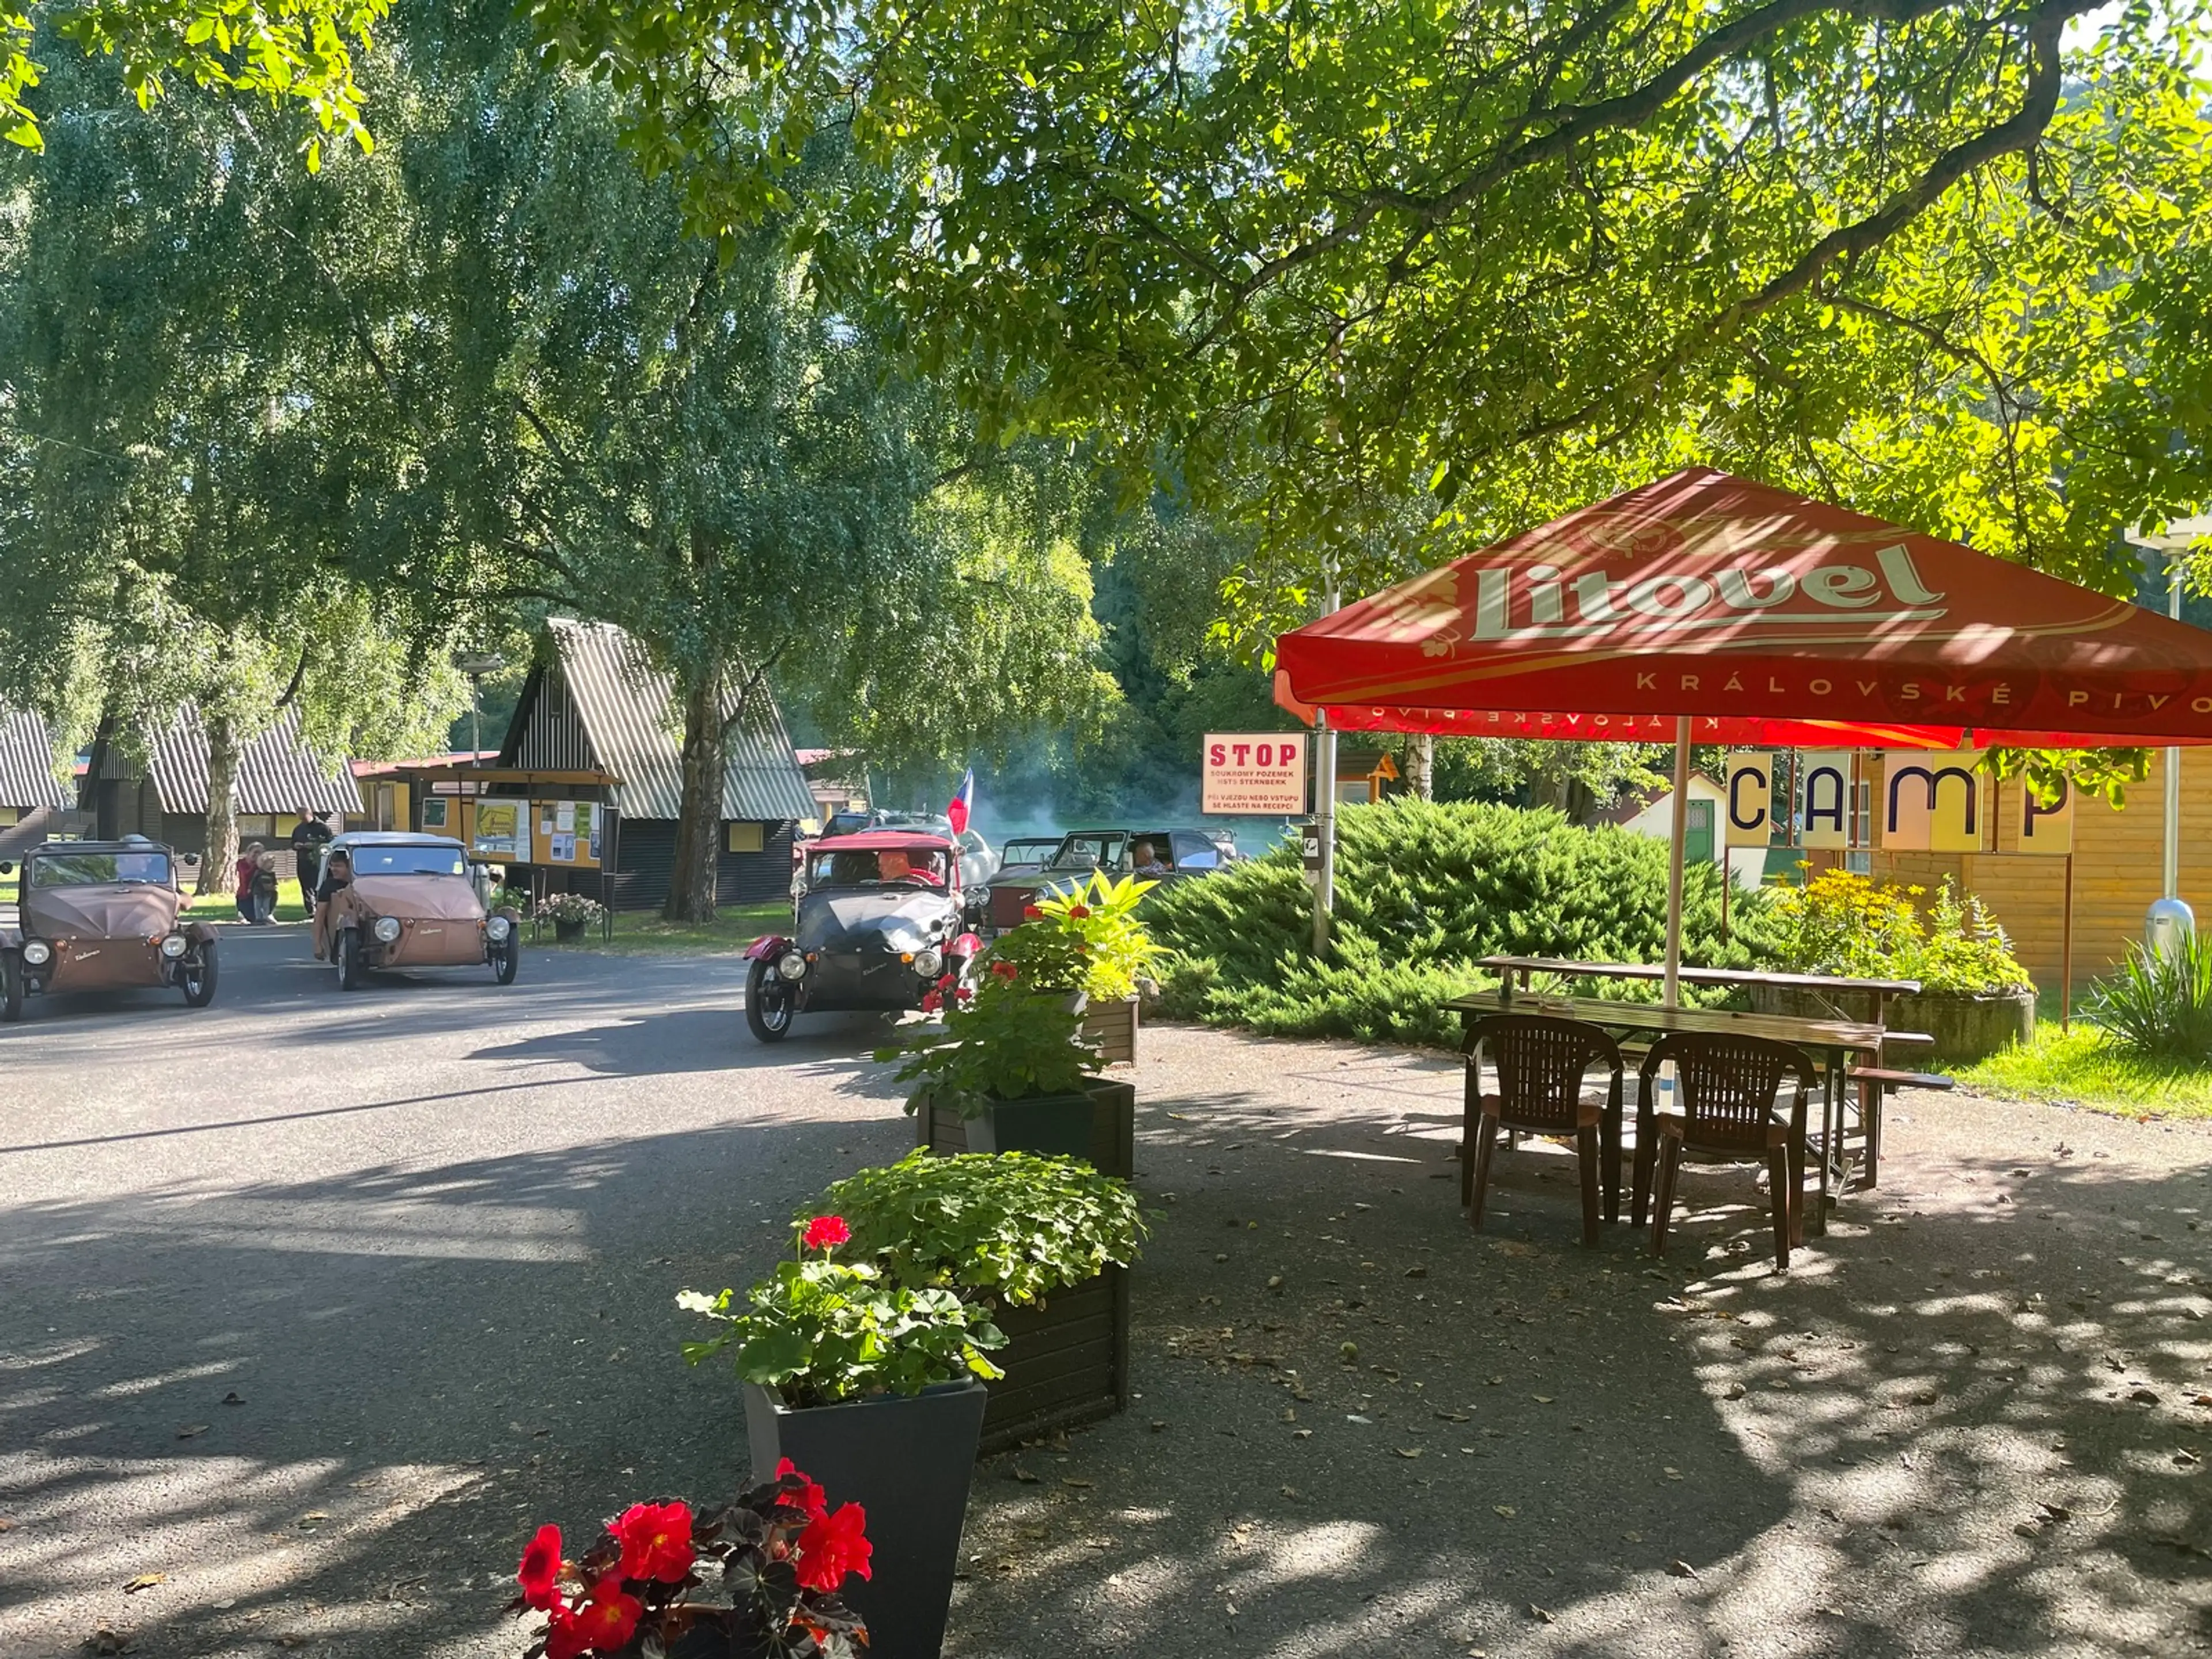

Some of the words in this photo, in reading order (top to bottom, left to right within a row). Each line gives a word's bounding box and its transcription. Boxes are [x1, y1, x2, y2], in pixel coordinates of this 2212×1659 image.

[1469, 543, 1948, 641] Litovel
[1636, 671, 2012, 705] KRÁLOVSKÉ
[2068, 690, 2212, 714] PIVO
[1211, 744, 1296, 766] STOP
